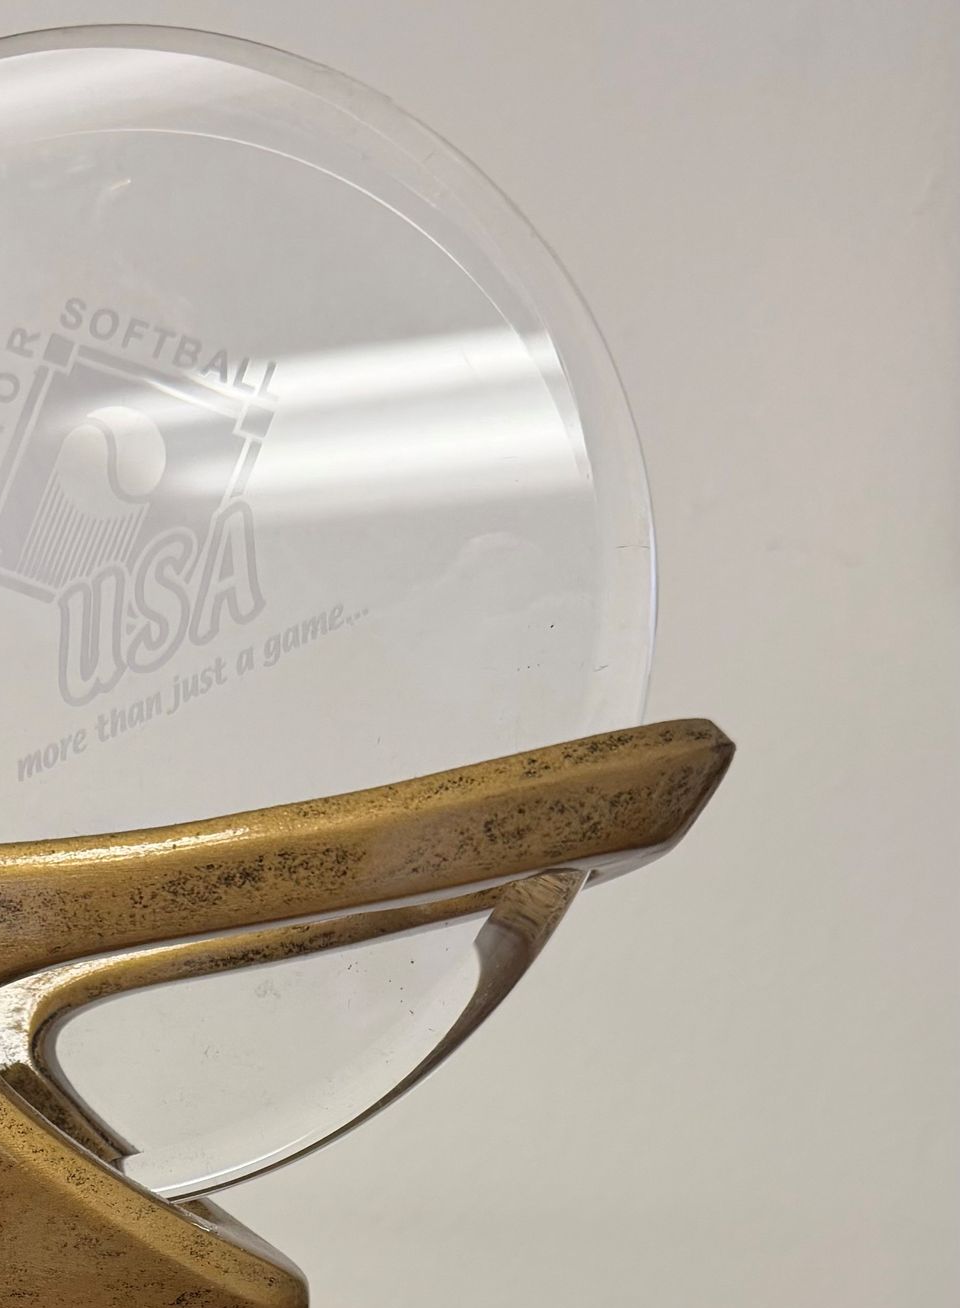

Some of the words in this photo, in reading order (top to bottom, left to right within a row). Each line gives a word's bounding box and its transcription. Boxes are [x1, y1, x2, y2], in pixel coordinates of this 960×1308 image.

[59, 297, 279, 401] SOFTBALL
[58, 500, 267, 707] USA
[16, 732, 88, 782] more
[96, 697, 163, 744] than
[167, 656, 228, 716] just
[235, 646, 255, 676] a
[263, 604, 370, 667] game...
